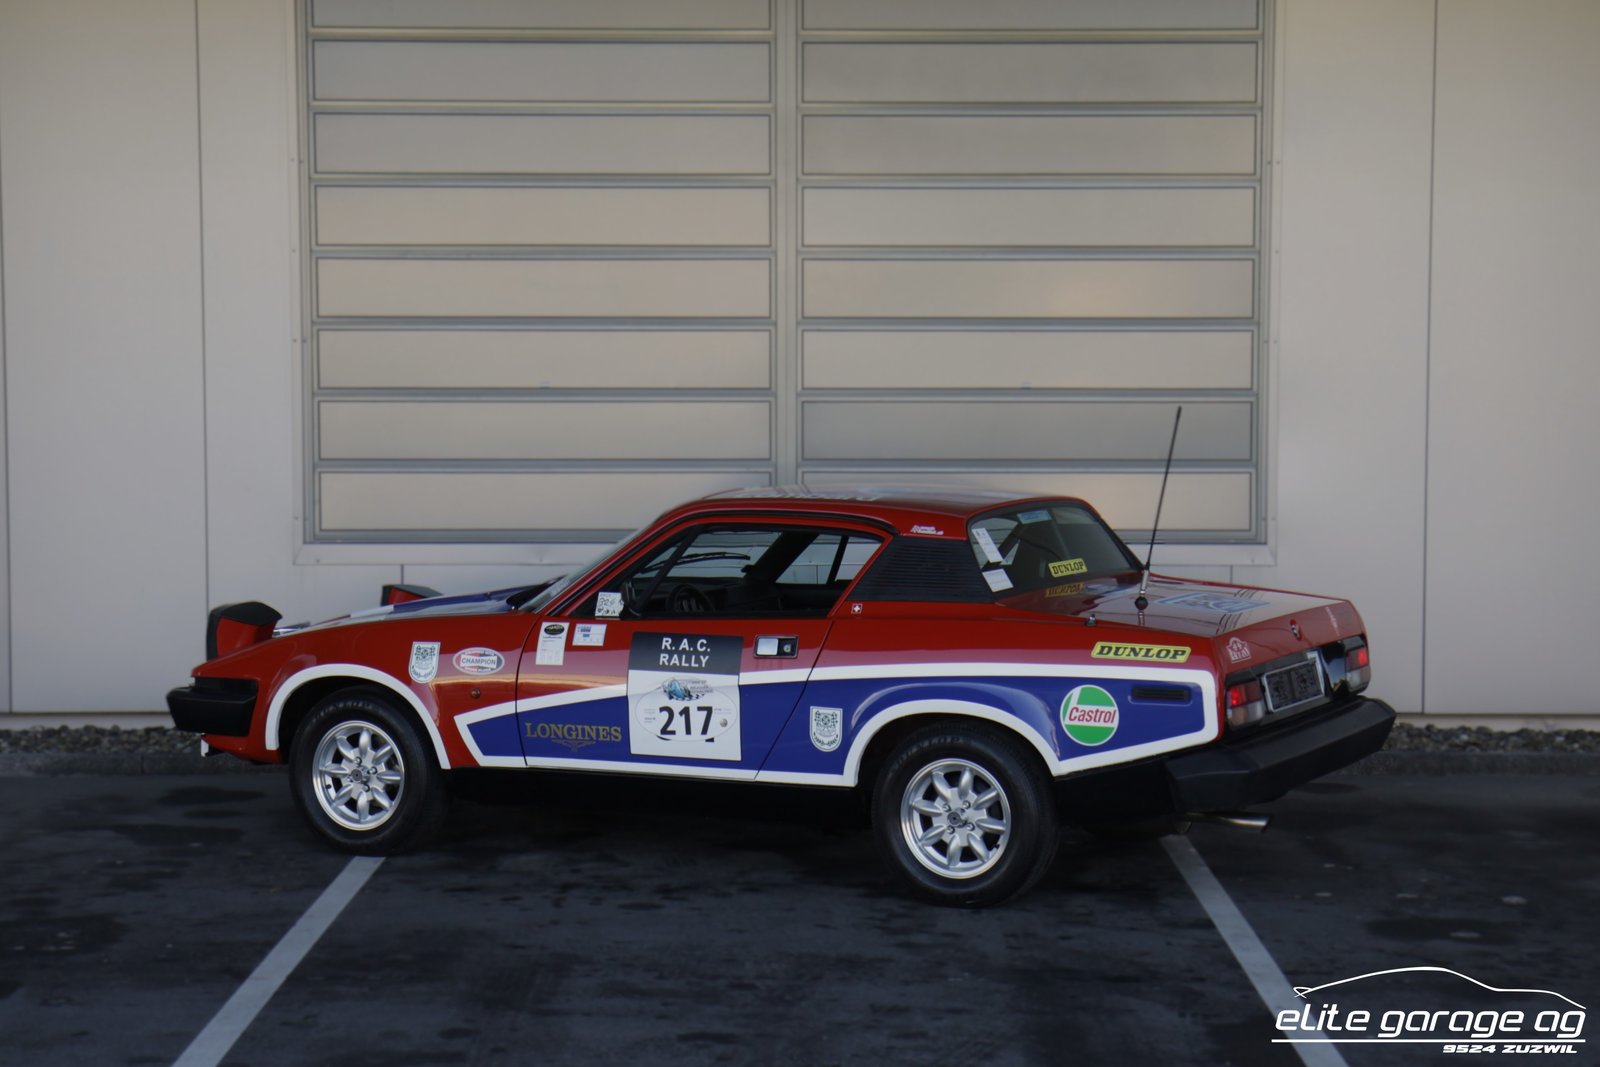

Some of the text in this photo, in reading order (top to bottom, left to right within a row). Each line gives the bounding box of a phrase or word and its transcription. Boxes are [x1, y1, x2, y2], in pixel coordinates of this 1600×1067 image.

[1051, 561, 1085, 575] DUNLOP
[659, 653, 710, 668] RALLY
[1096, 645, 1187, 661] DUNLOP
[461, 658, 497, 666] CHAMPION
[659, 705, 713, 736] 217
[1068, 705, 1117, 724] Castrol
[525, 722, 623, 742] LONGINES
